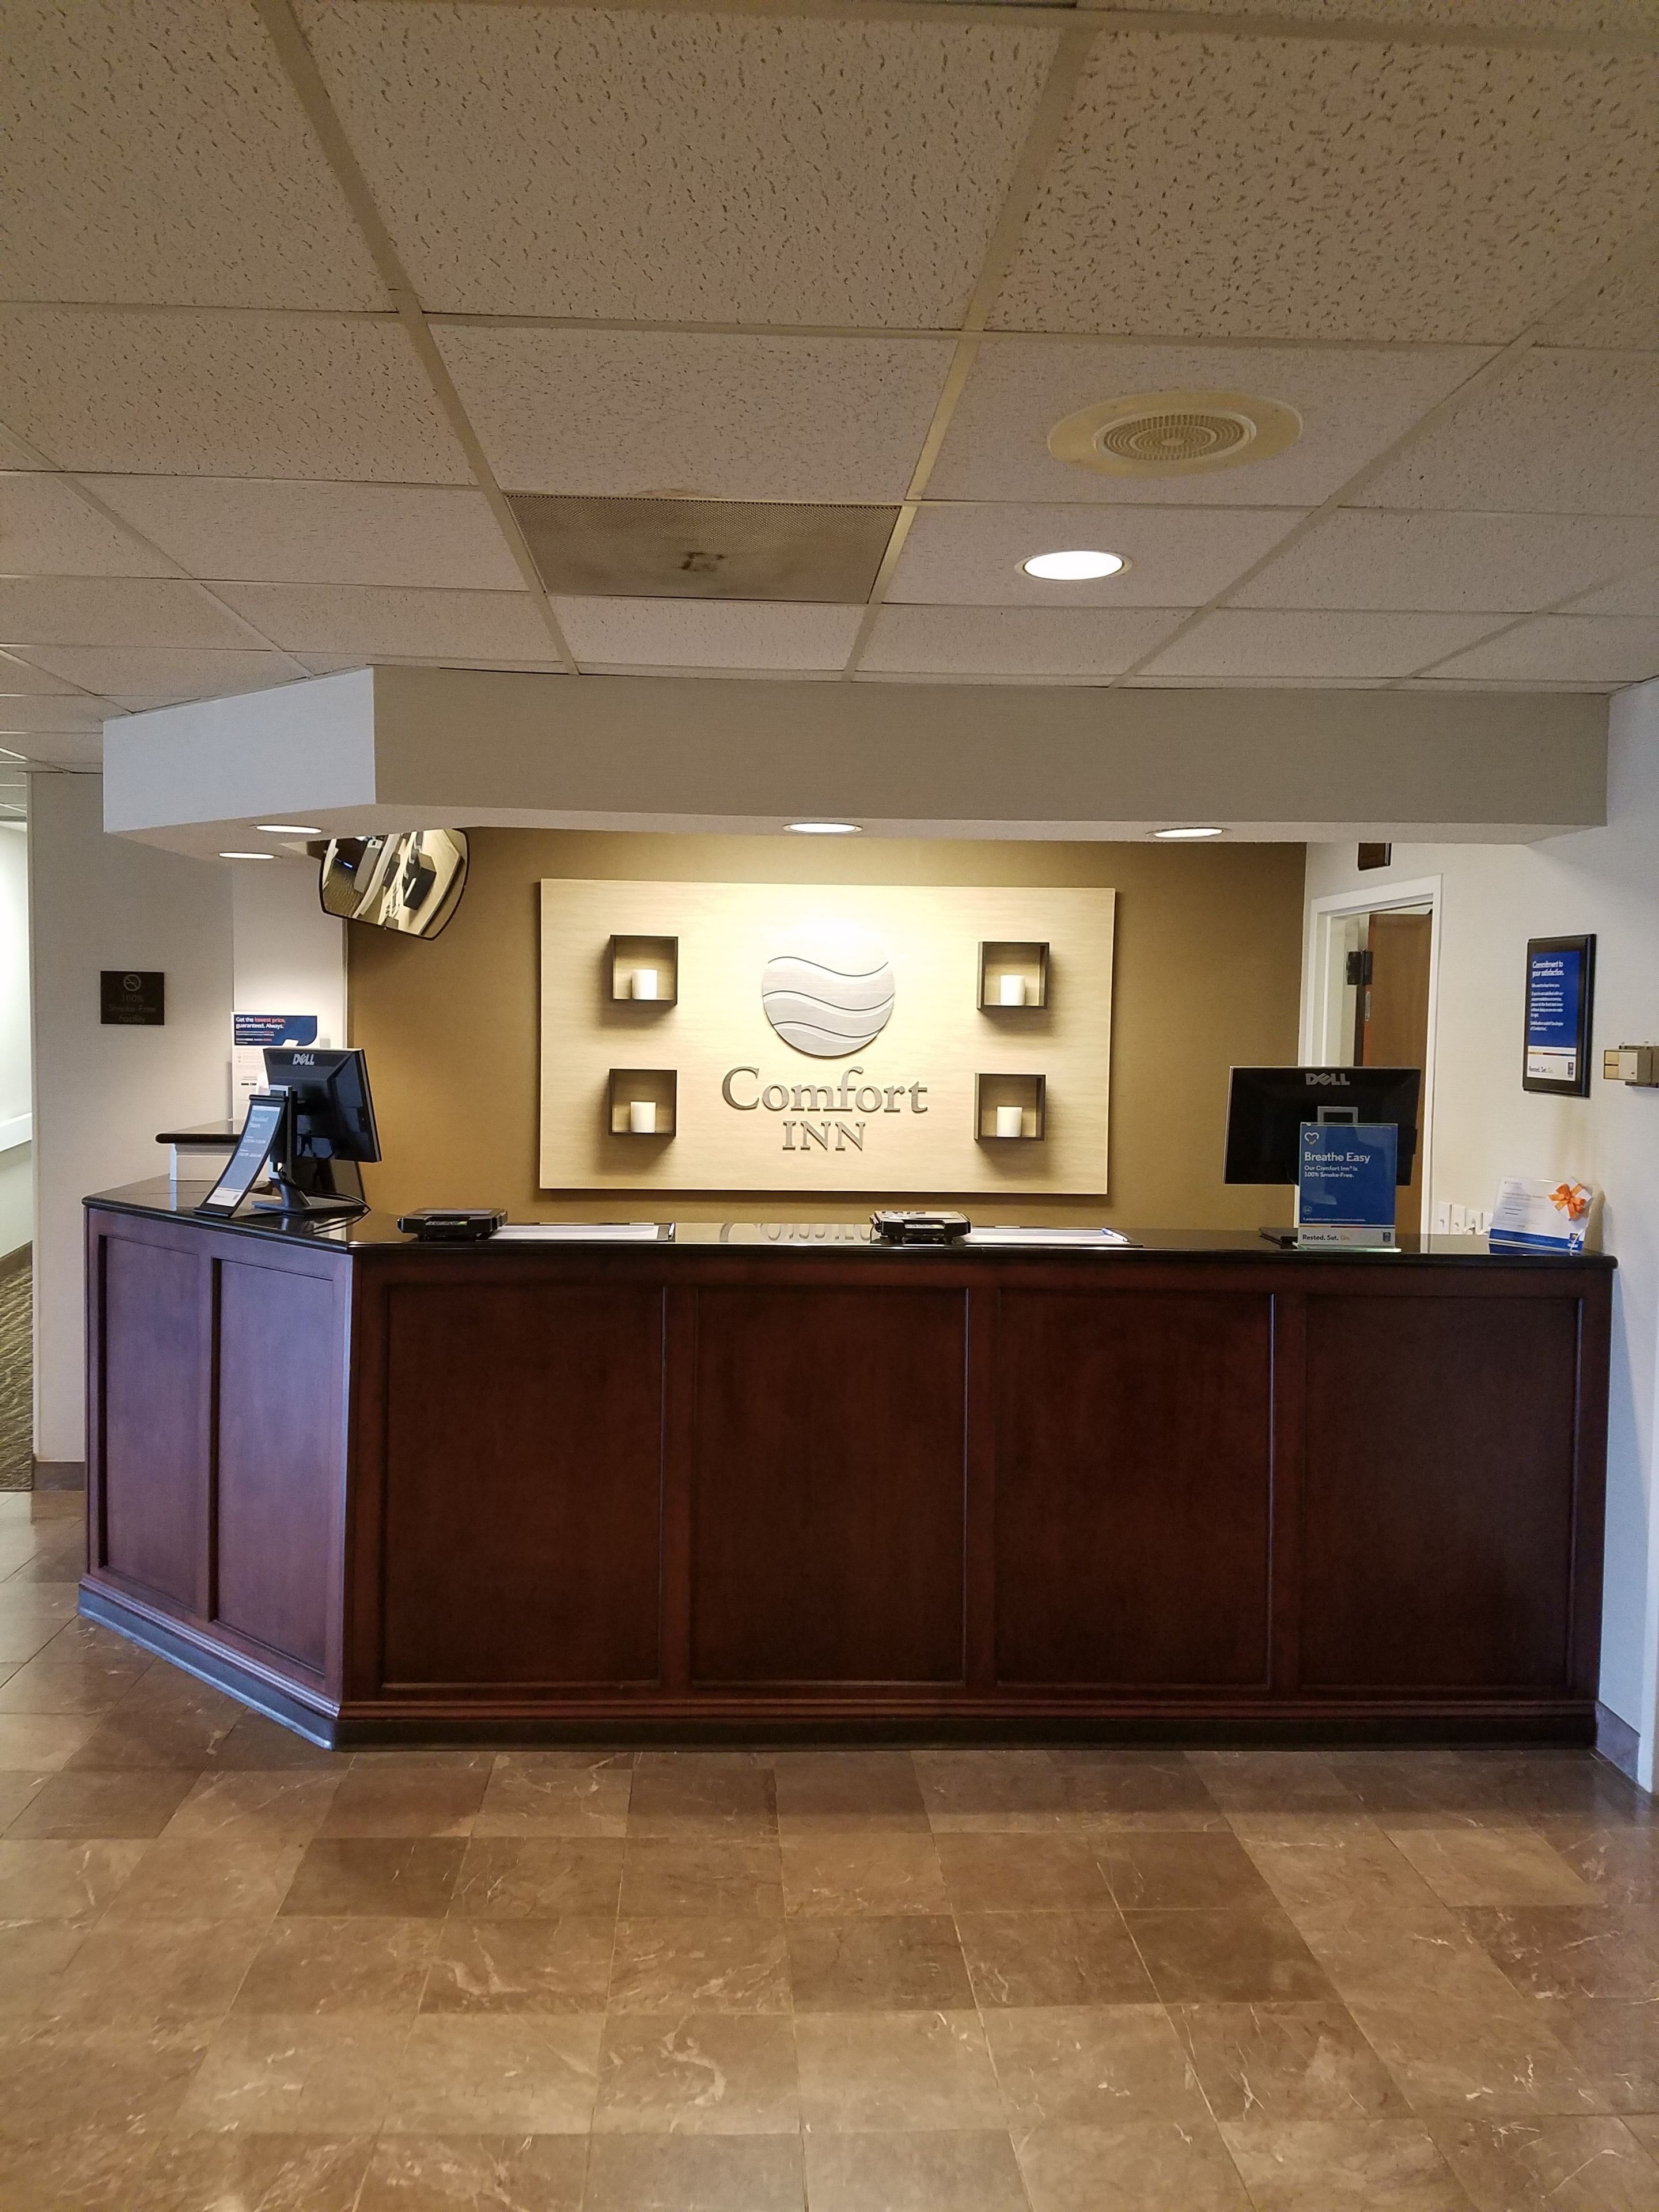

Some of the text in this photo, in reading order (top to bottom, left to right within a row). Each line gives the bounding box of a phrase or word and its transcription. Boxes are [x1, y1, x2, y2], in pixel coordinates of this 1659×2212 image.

[122, 995, 143, 1003] 100%
[292, 1053, 315, 1066] DELL
[1305, 1073, 1350, 1086] DELL
[722, 1066, 928, 1113] Comfort
[782, 1121, 866, 1152] INN
[1304, 1152, 1371, 1164] Breathe Easy
